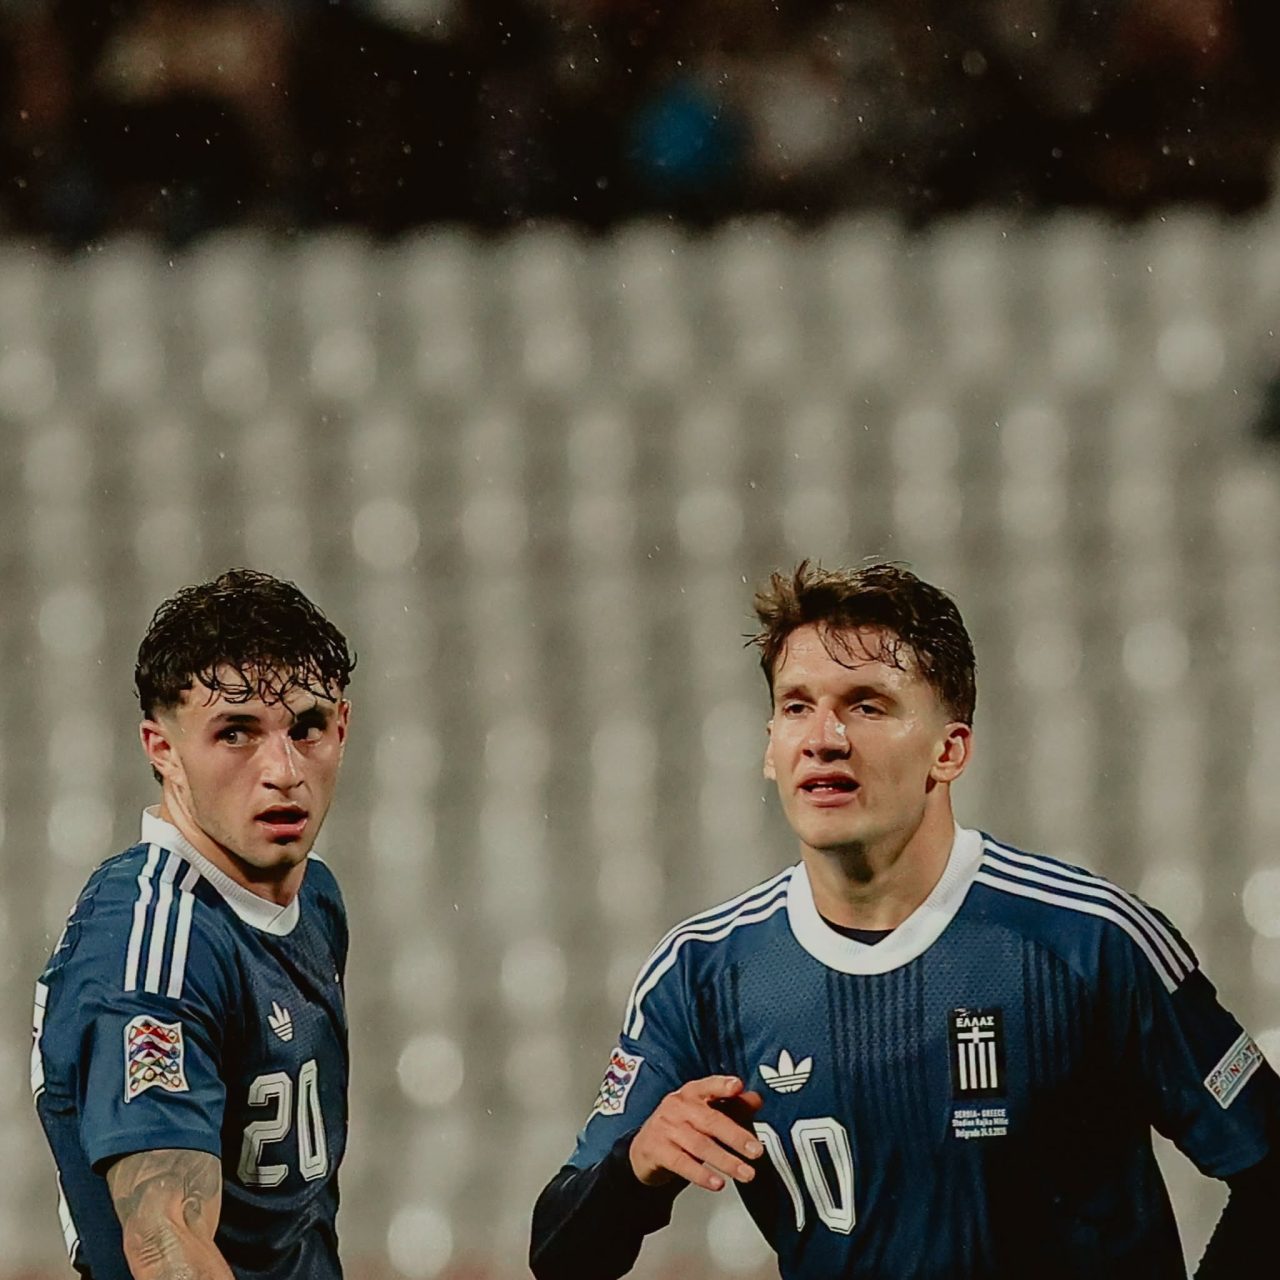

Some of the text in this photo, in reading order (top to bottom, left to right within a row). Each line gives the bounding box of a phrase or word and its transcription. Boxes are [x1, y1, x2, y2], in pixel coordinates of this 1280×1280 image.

[956, 1016, 994, 1028] ΕΛΛΑΣ
[237, 1058, 329, 1188] 20
[753, 1116, 856, 1235] 10
